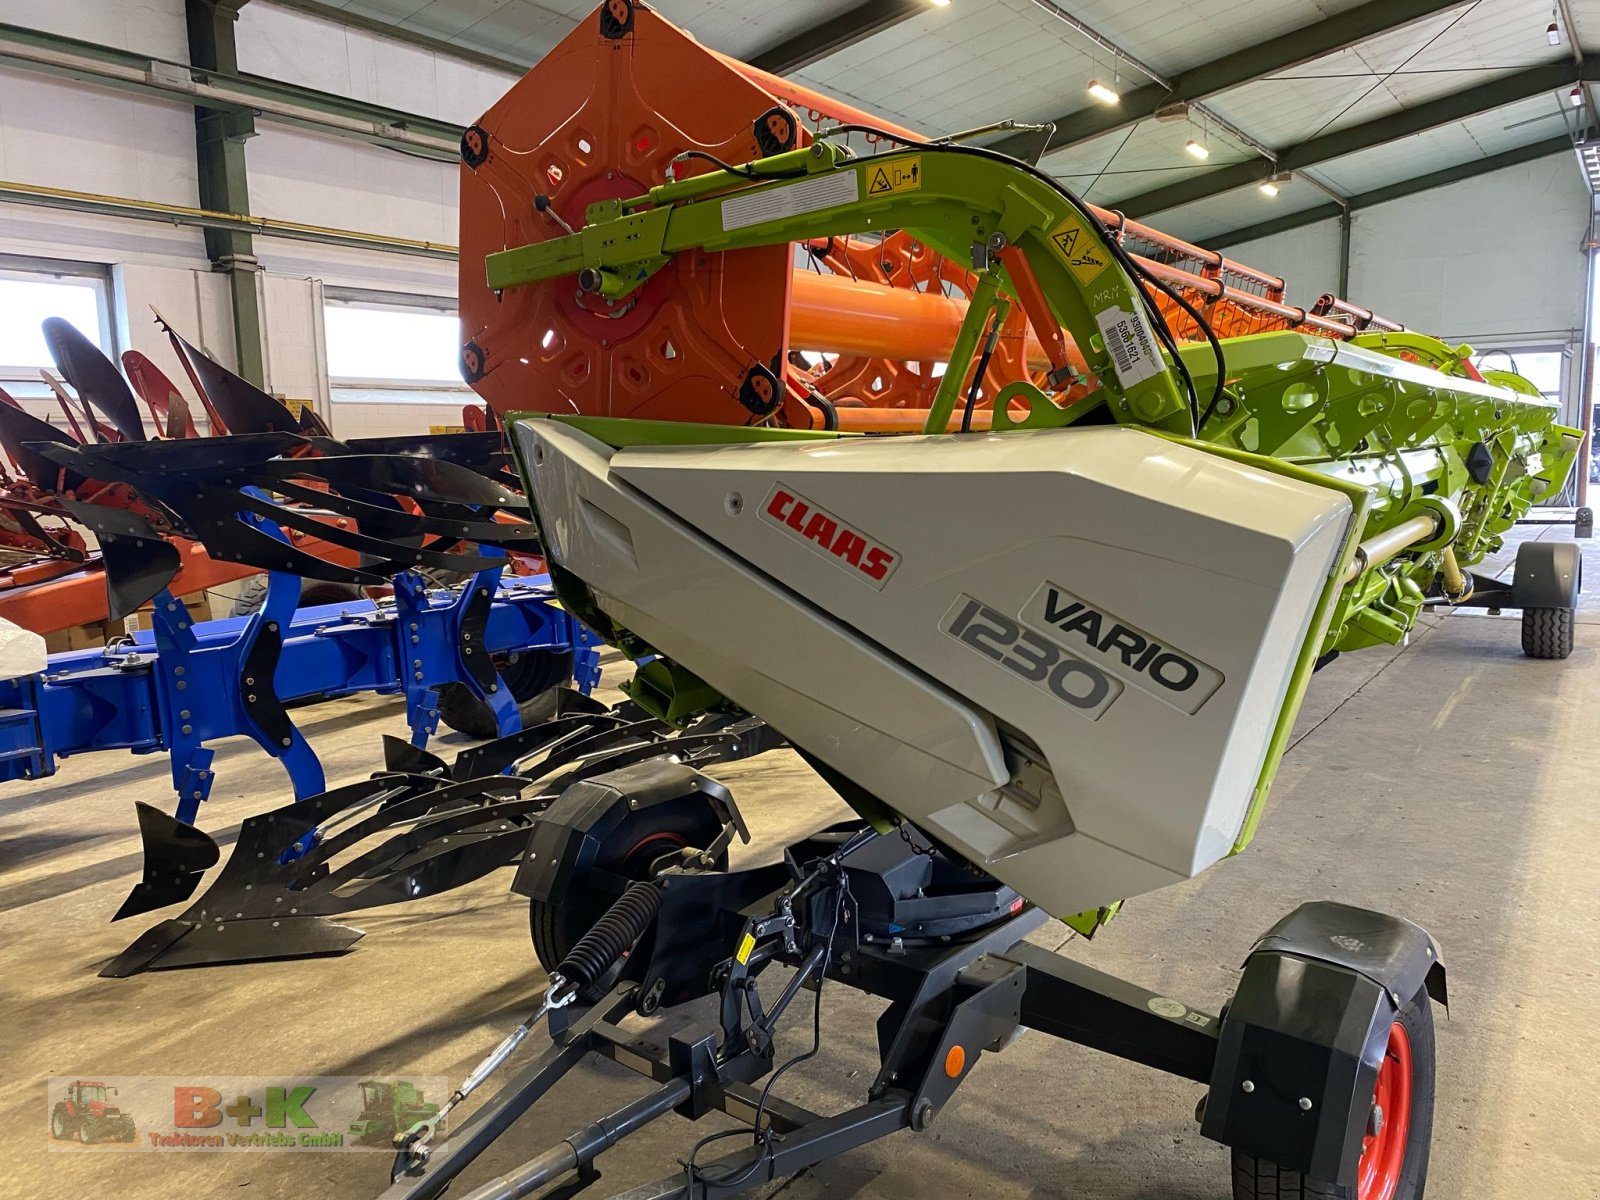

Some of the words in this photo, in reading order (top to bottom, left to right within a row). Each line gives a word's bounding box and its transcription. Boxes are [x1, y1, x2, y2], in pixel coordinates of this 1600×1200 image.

[766, 490, 894, 581] CLAAS
[947, 600, 1110, 709] 1230
[1043, 588, 1199, 692] VARIO
